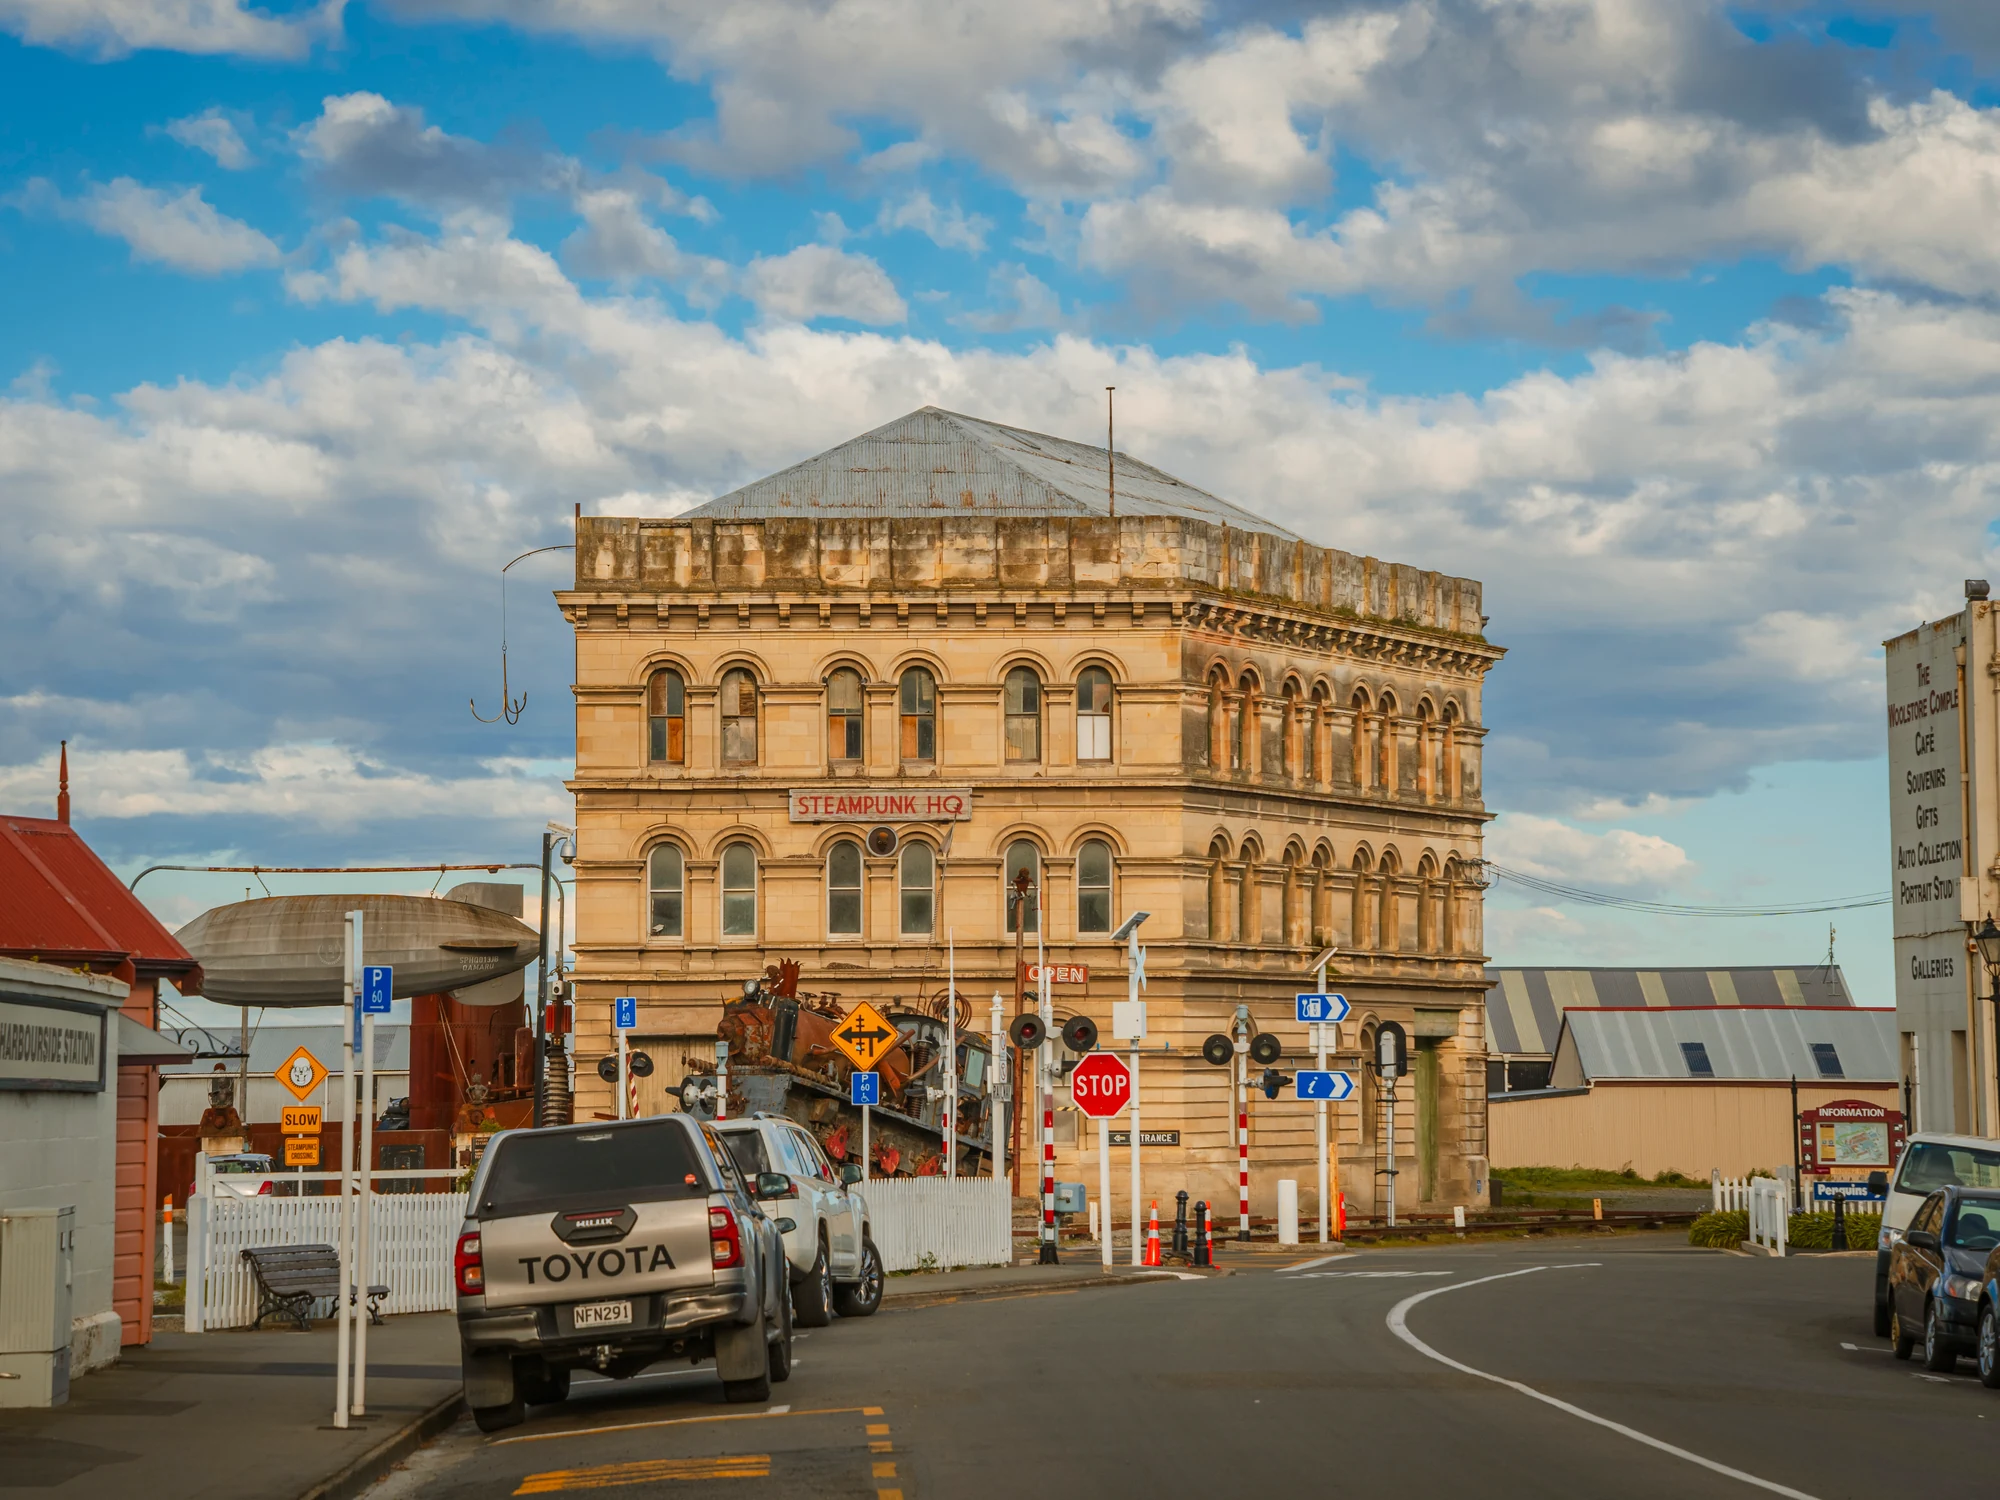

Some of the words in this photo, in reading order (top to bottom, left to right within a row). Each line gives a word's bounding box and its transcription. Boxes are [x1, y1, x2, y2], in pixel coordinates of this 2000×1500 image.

[1929, 688, 1959, 715] COMPLE
[798, 795, 916, 815] STEAMPUNK
[927, 795, 963, 815] HQ
[462, 963, 495, 971] OAMARU
[372, 969, 382, 987] P
[1028, 965, 1084, 983] OPEN
[371, 990, 383, 1003] 60
[622, 999, 630, 1011] P
[621, 1012, 631, 1022] 60
[0, 1022, 62, 1063] HARBOURSIDE
[63, 1028, 96, 1066] STATION
[861, 1074, 869, 1083] P
[860, 1083, 870, 1092] 60
[1076, 1074, 1127, 1097] STOP
[1818, 1108, 1885, 1117] INFORMATION
[285, 1113, 318, 1126] SLOW
[1130, 1134, 1172, 1143] TRANCE
[287, 1143, 317, 1151] STEAMPUNKS
[1817, 1183, 1868, 1197] Penguins
[575, 1217, 613, 1228] HILUX
[518, 1244, 676, 1285] TOYOTA
[575, 1304, 630, 1324] NFN291
